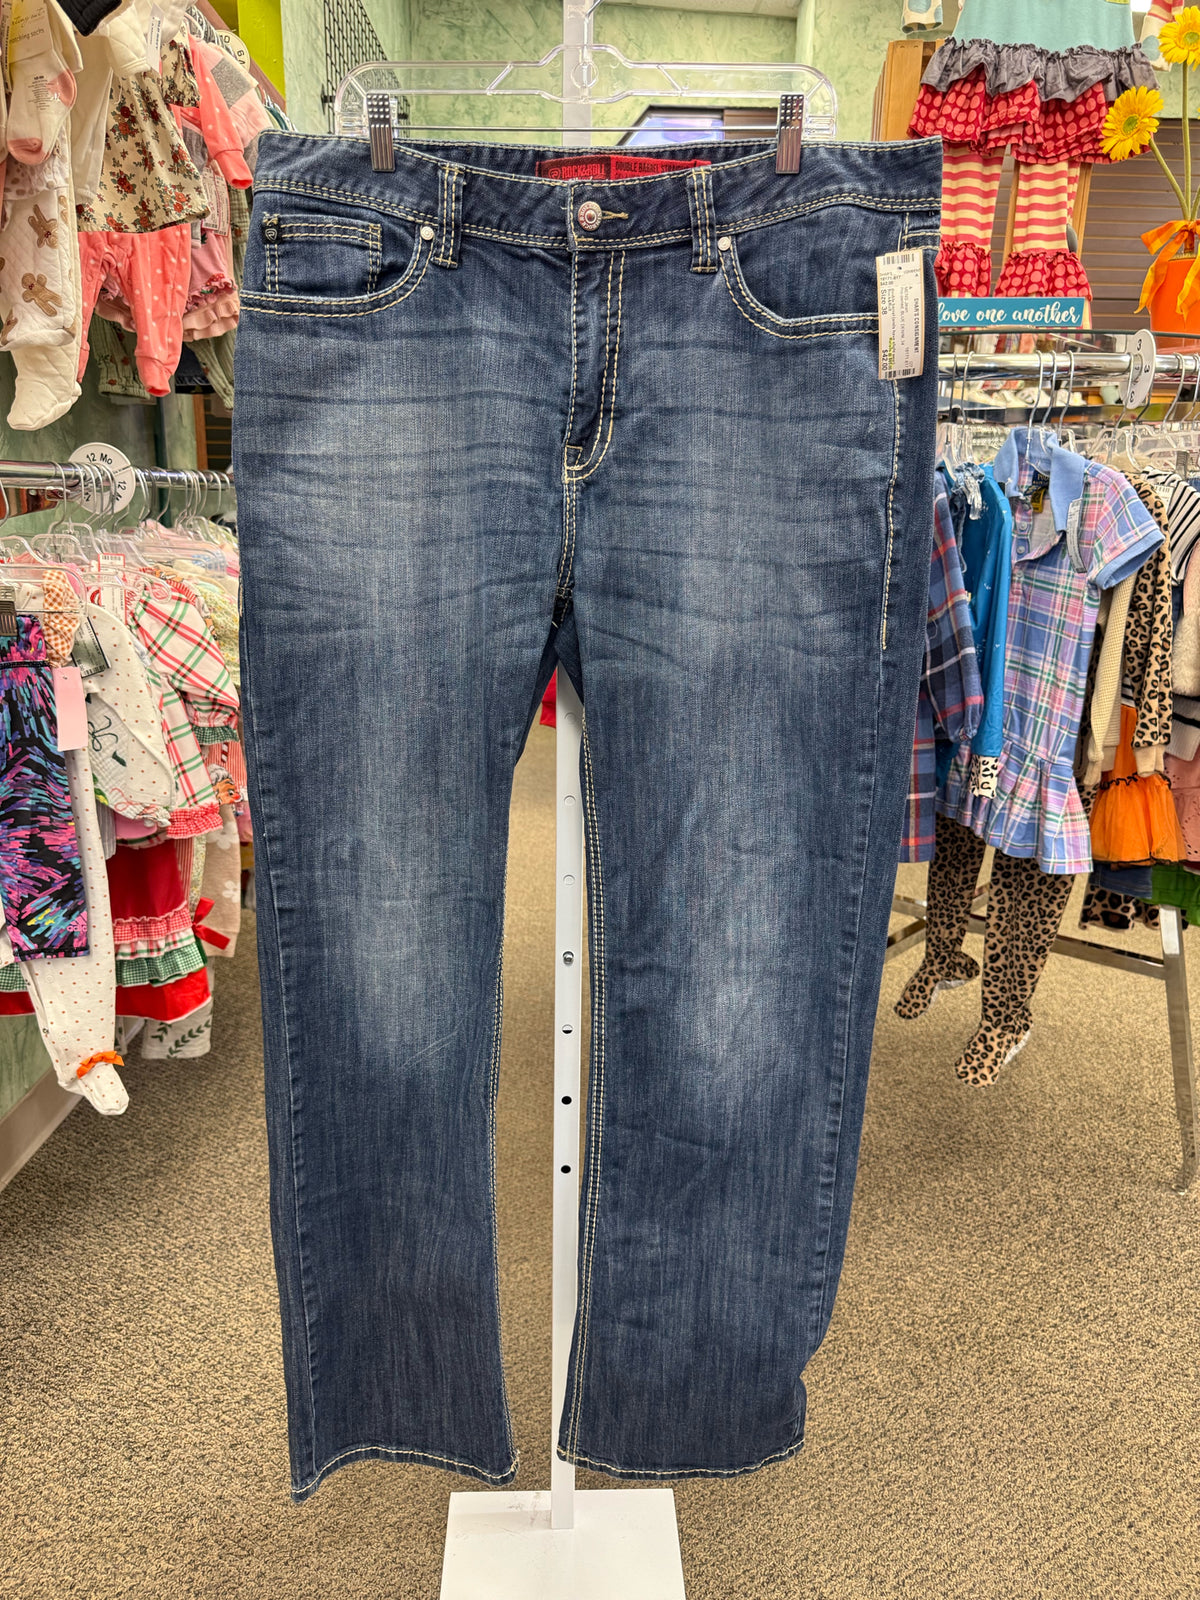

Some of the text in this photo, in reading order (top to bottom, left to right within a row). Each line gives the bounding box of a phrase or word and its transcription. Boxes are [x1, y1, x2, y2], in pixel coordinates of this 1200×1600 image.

[615, 161, 637, 172] DOUBLE
[638, 162, 659, 173] BARREL
[881, 306, 888, 315] 38
[938, 301, 1080, 324] love one another
[86, 452, 113, 465] 12 Mo
[117, 480, 127, 491] 12
